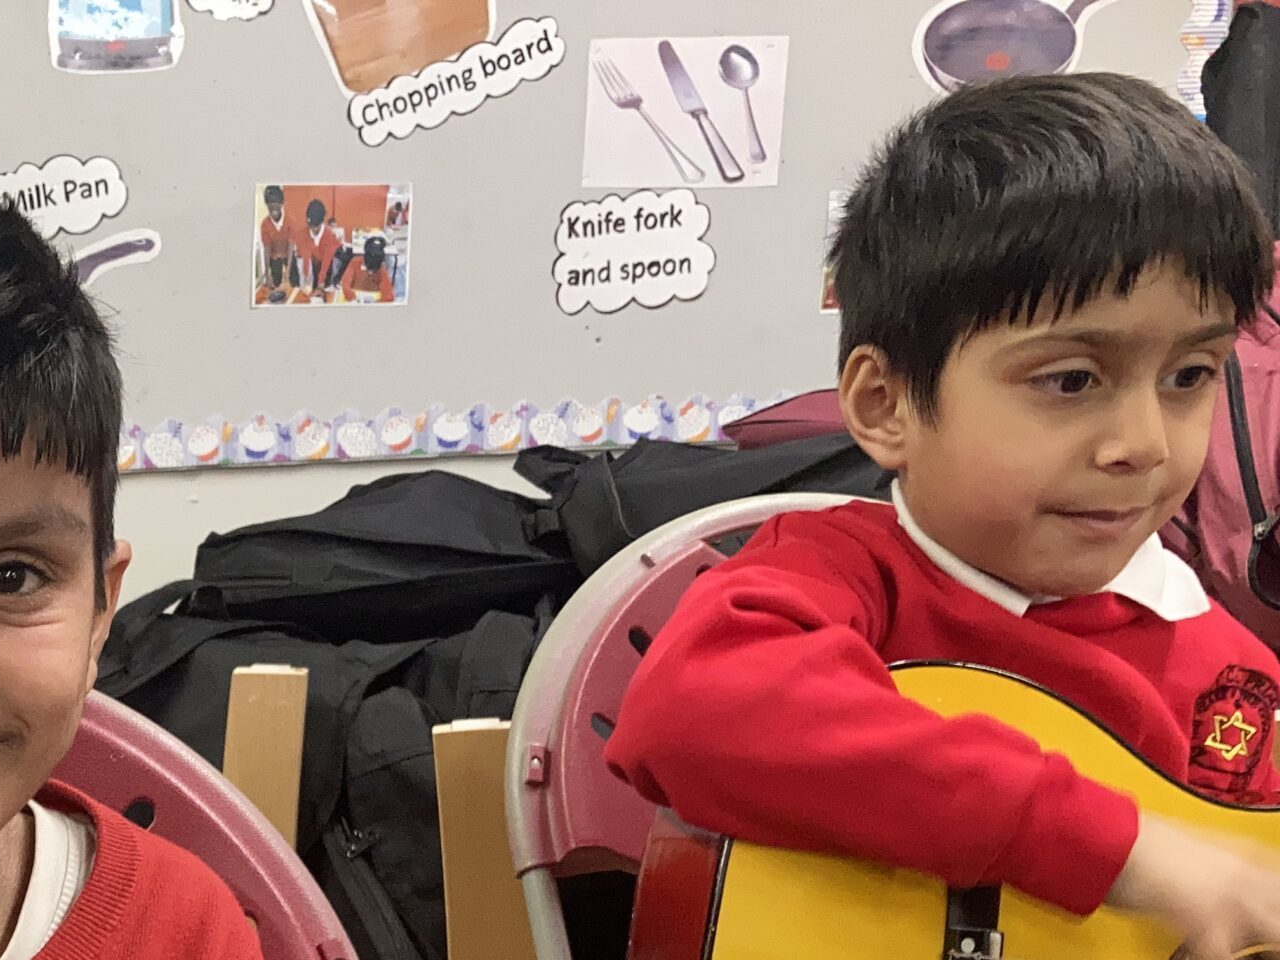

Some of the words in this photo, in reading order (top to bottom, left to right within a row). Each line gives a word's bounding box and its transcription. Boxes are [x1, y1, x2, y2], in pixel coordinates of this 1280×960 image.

[362, 68, 477, 125] Chopping
[479, 28, 553, 79] board
[63, 178, 109, 203] Pan
[567, 210, 625, 239] Knife
[634, 203, 682, 232] fork
[567, 259, 611, 286] and
[620, 257, 691, 284] spoon
